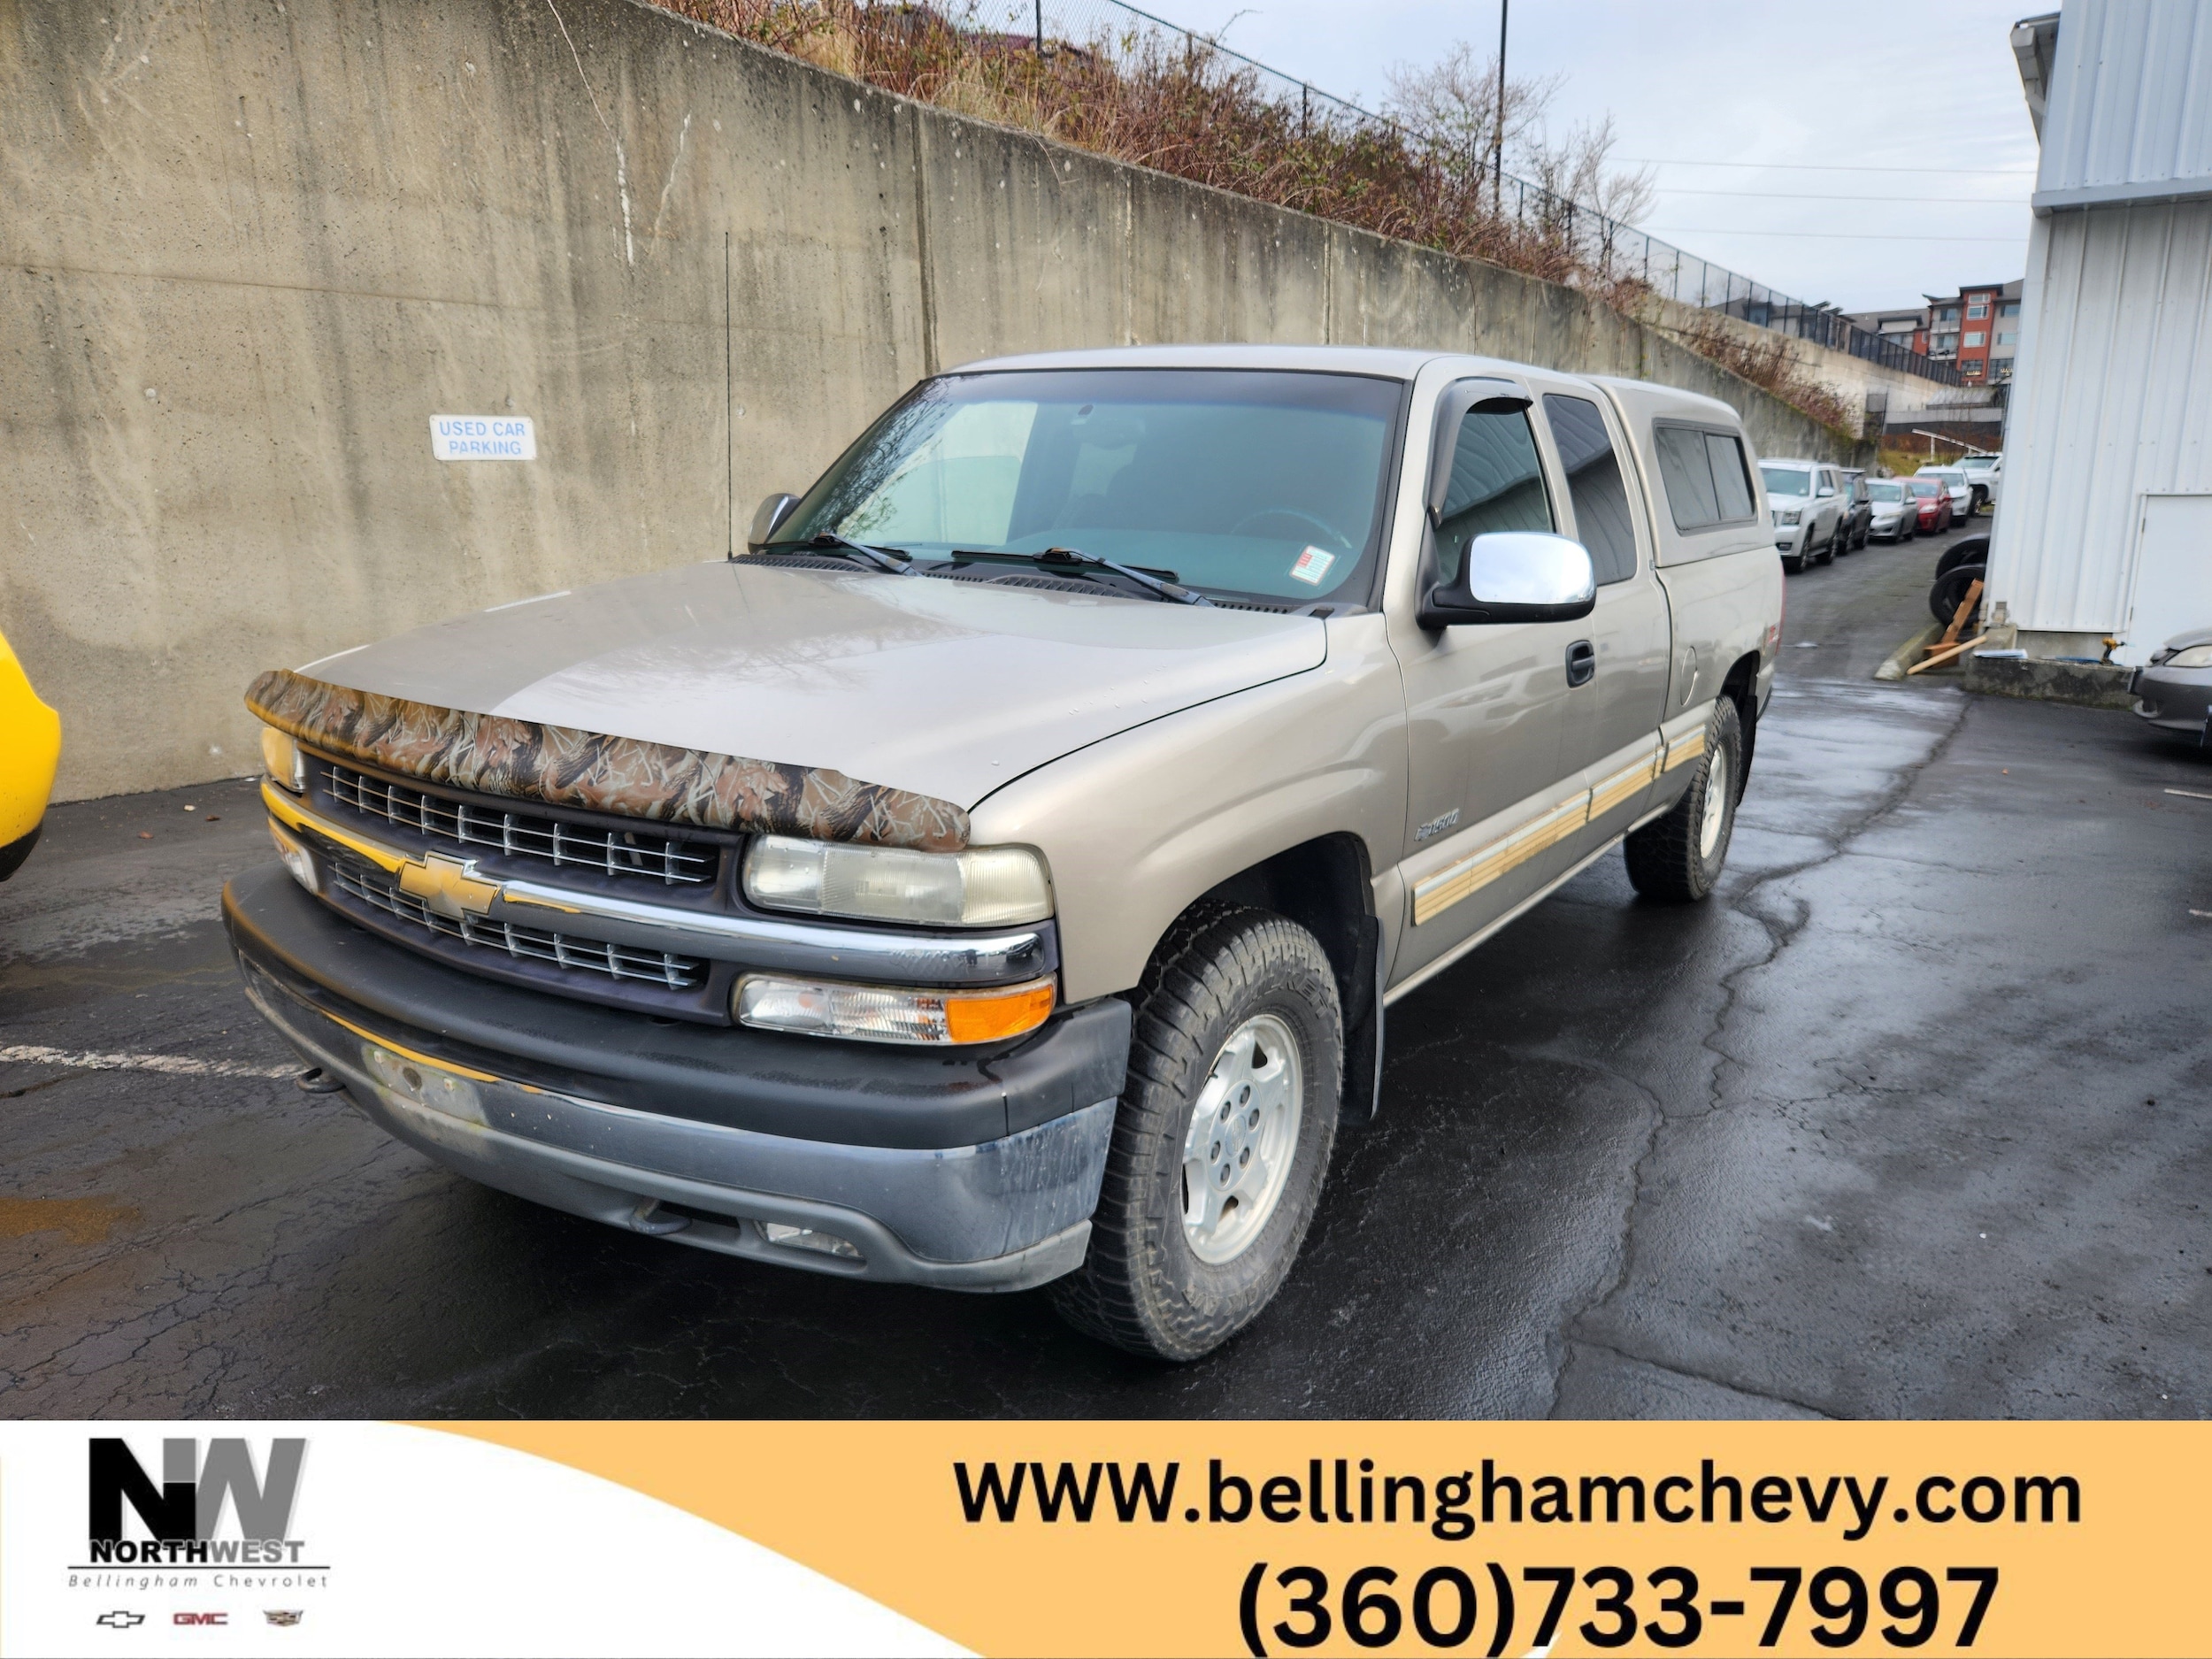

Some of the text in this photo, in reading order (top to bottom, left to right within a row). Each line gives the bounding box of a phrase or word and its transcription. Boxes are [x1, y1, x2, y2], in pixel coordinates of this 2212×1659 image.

[439, 421, 526, 437] USED CAR
[449, 441, 522, 455] PARKING
